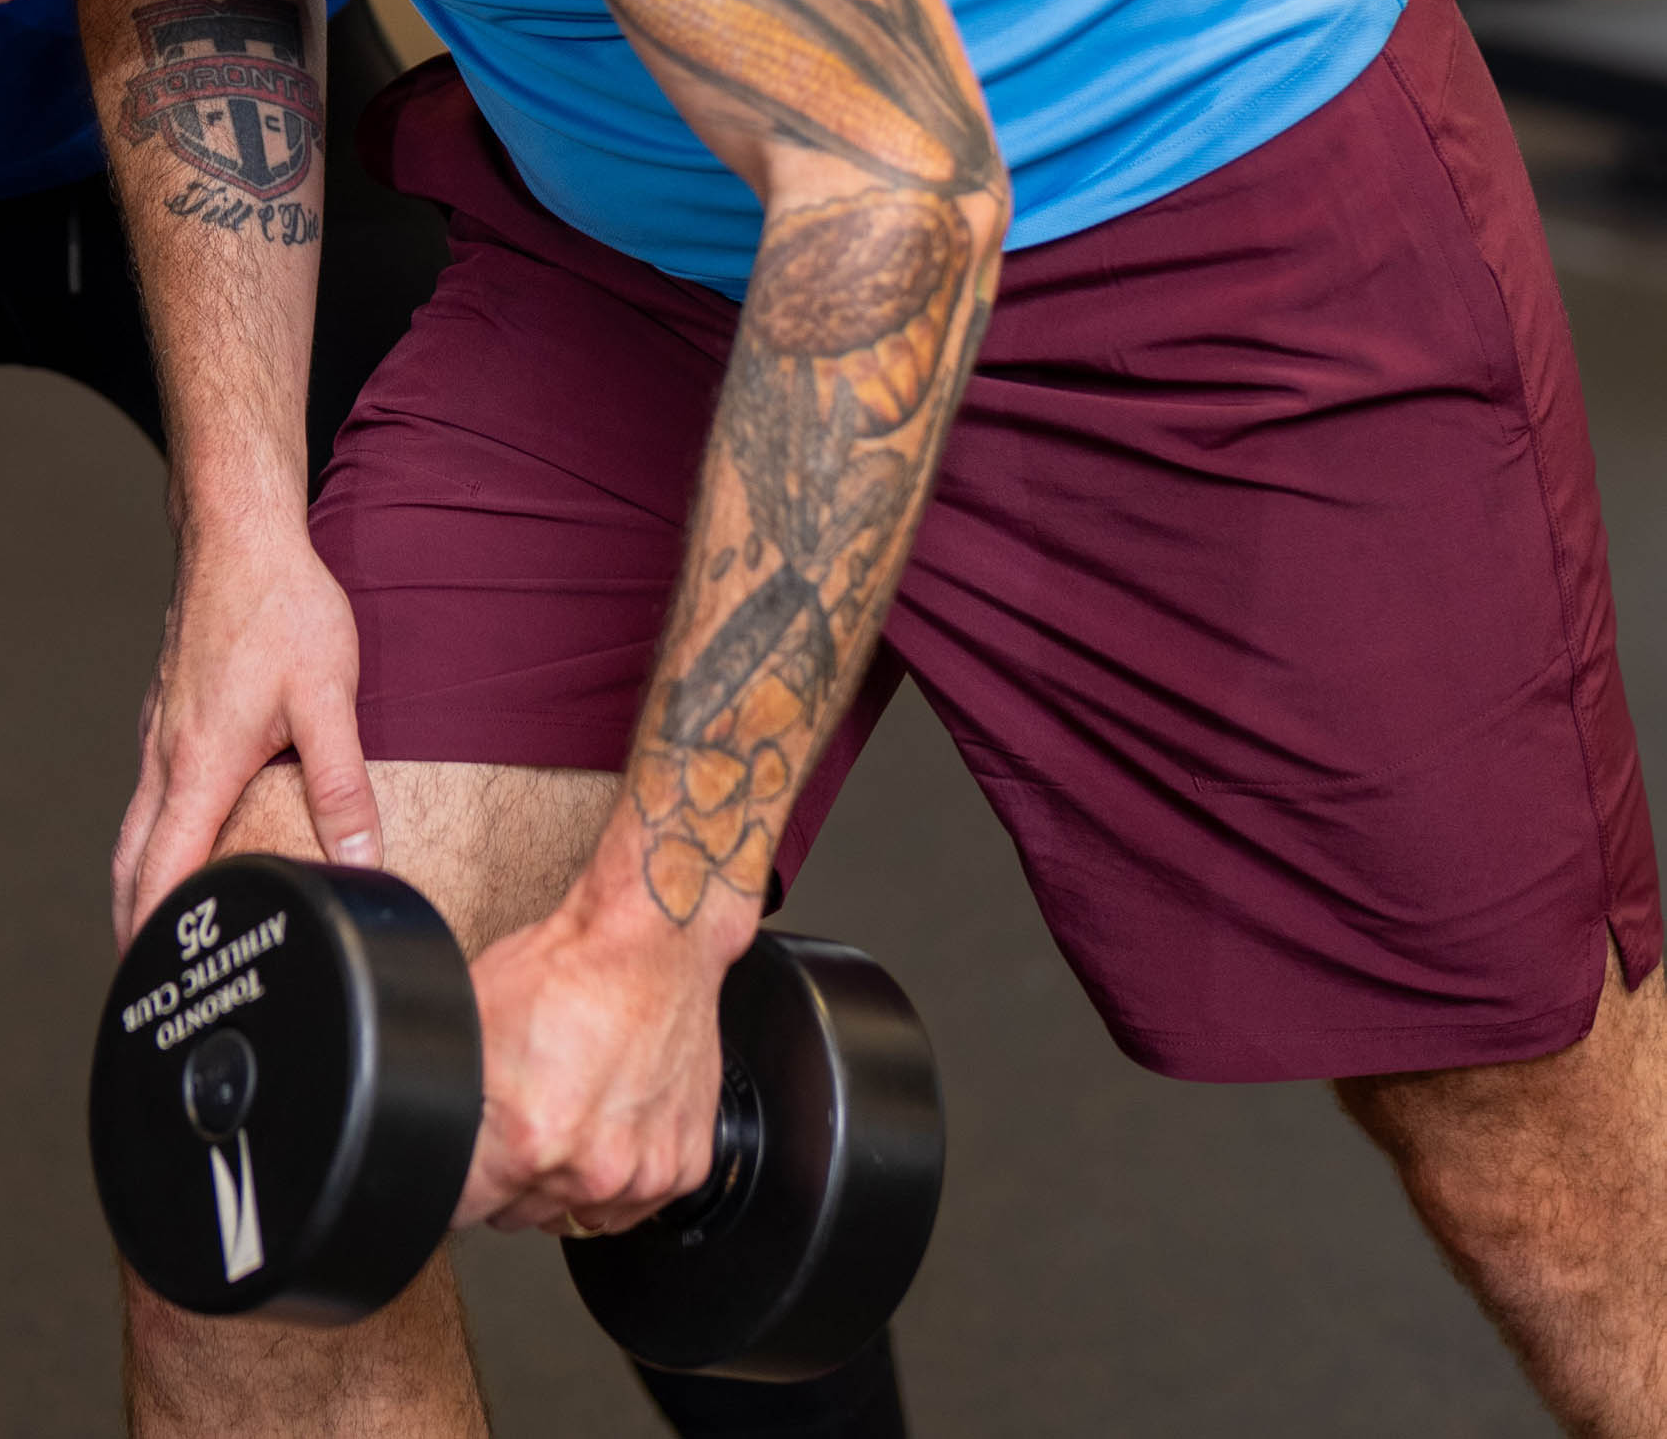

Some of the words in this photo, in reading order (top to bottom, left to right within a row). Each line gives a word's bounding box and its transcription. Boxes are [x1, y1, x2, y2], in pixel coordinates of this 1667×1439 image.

[138, 64, 313, 109] TORONTO
[176, 896, 220, 961] 25
[181, 911, 286, 998] ATHLETIC
[156, 967, 265, 1050] TORONTO
